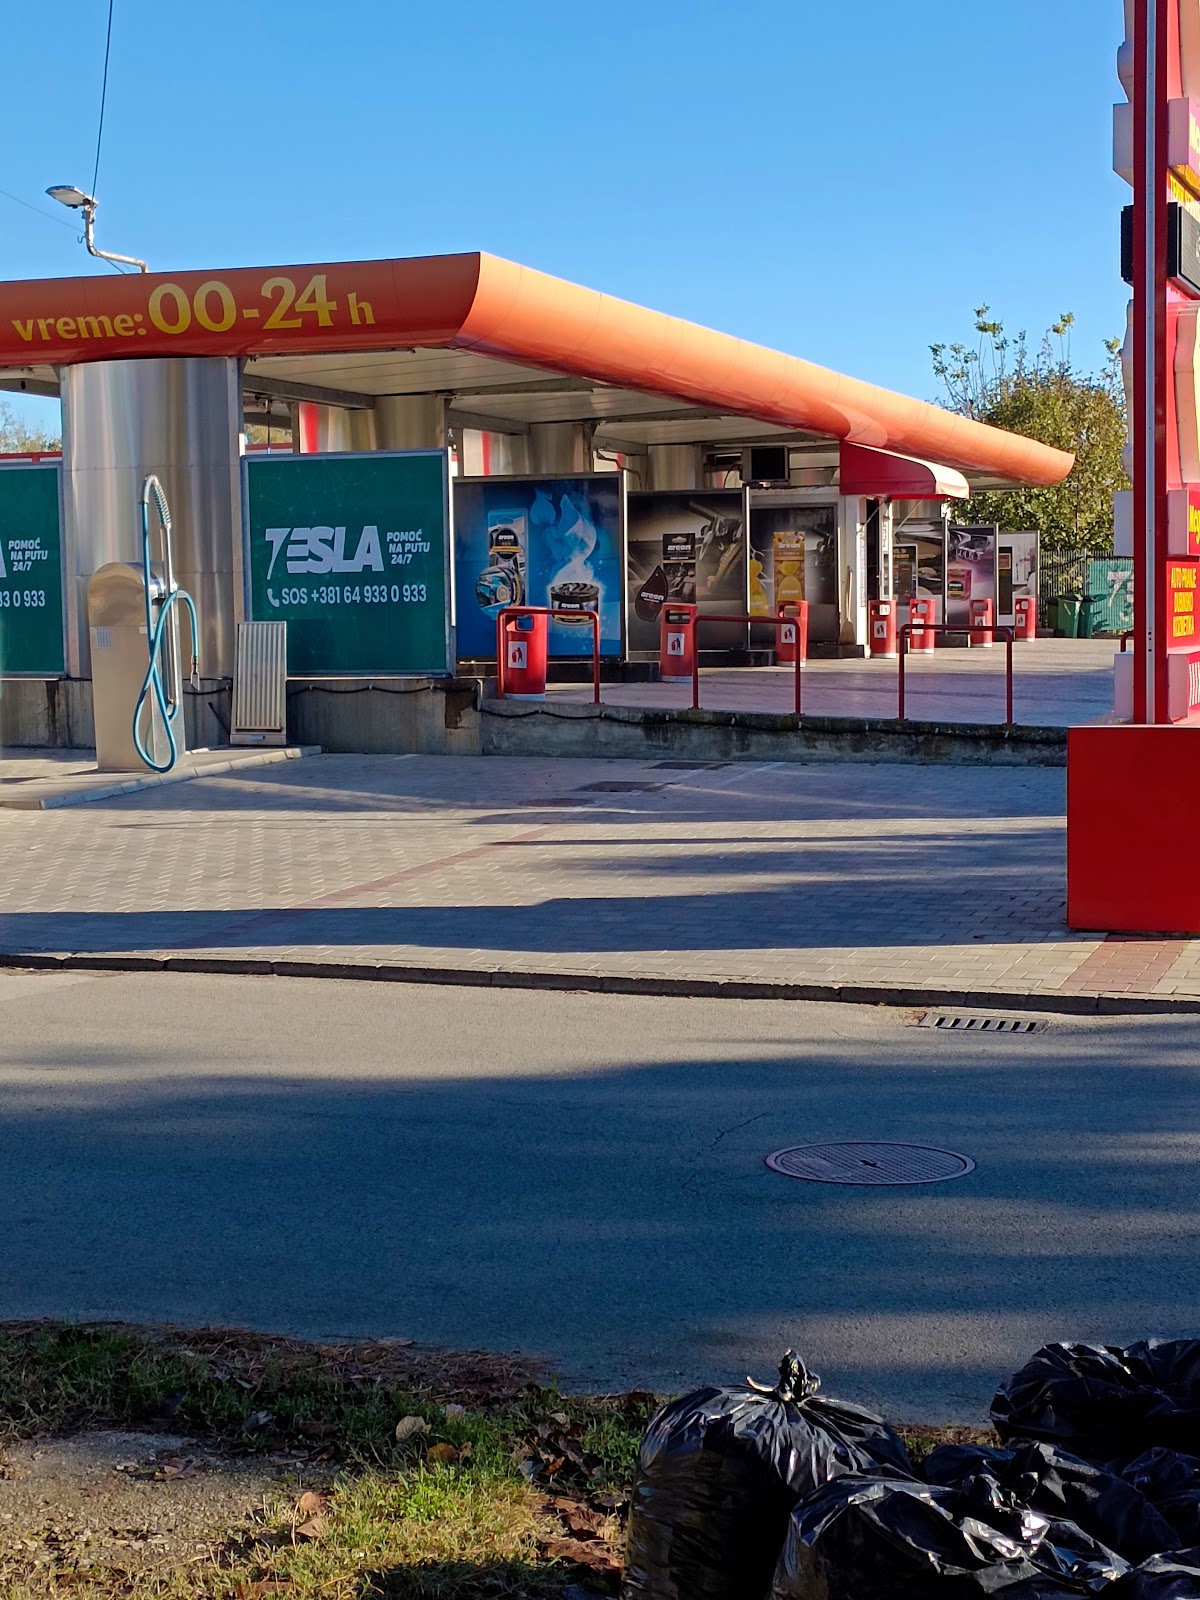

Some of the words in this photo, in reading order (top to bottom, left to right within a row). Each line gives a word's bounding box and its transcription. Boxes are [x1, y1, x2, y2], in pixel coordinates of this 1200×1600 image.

[12, 312, 147, 342] vreme:
[347, 292, 376, 326] h
[386, 529, 422, 542] POMOĆ
[8, 537, 41, 551] POMOĆ
[388, 543, 403, 553] NA
[404, 542, 431, 553] PUTU
[10, 550, 24, 561] NA
[24, 550, 49, 560] PUTU
[265, 525, 385, 580] TESLA
[391, 554, 413, 565] 24/7
[12, 561, 33, 572] 24/7
[12, 590, 21, 608] 0
[23, 589, 46, 608] 933
[281, 587, 308, 605] SOS
[311, 586, 341, 604] +381
[343, 586, 361, 604] 64
[363, 585, 388, 603] 933
[390, 584, 400, 603] 0
[402, 584, 427, 603] 933
